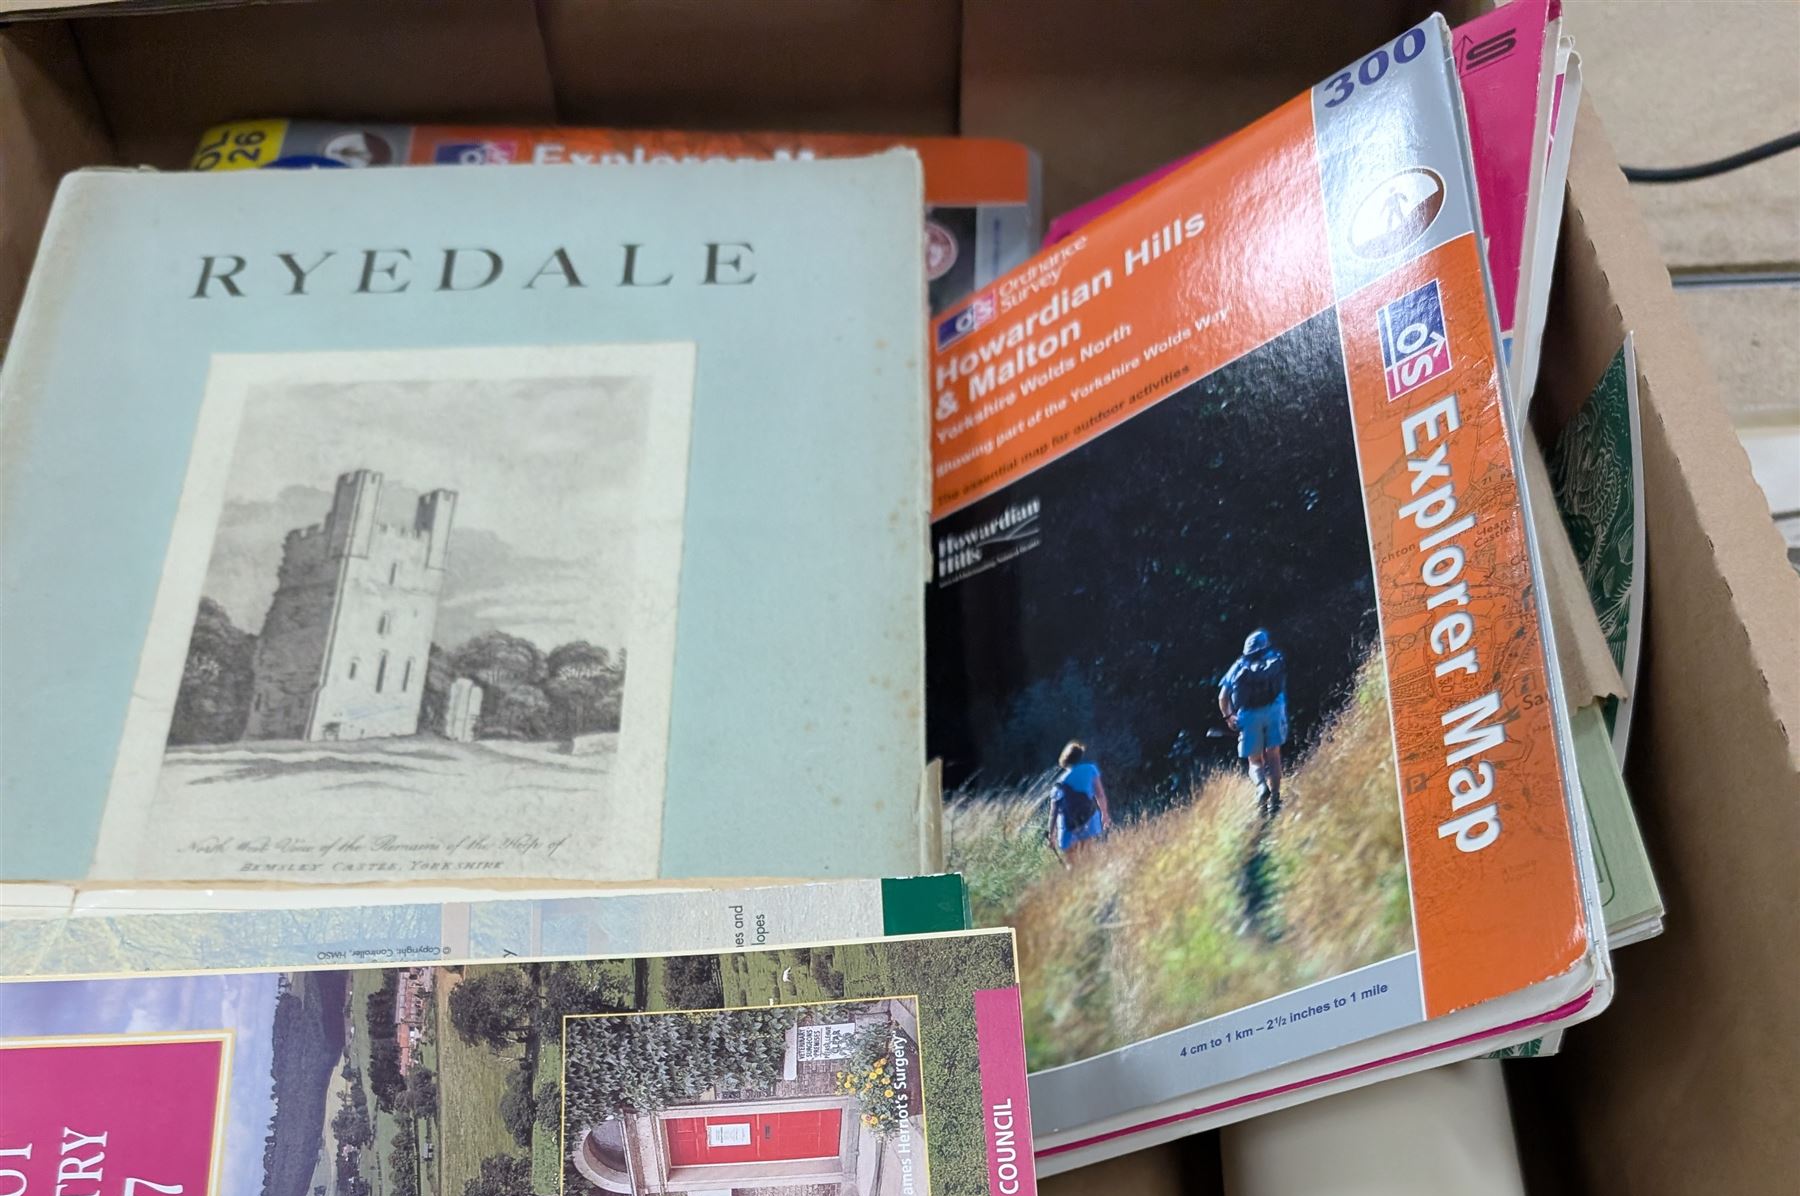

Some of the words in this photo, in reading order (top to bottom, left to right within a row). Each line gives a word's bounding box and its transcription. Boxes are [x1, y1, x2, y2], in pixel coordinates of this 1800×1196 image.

[1322, 27, 1427, 108] 300
[228, 130, 267, 163] 26
[187, 240, 761, 300] RYEDALE
[934, 268, 1114, 391] Howardian
[1124, 212, 1206, 276] Hills
[1000, 268, 1063, 314] Survey
[968, 319, 1082, 403] Malton
[1020, 353, 1076, 396] Wolds
[1080, 323, 1133, 362] North
[1071, 356, 1141, 402] Yorkshire
[1143, 327, 1192, 361] Wolds
[1073, 402, 1125, 434] outdoor
[1129, 364, 1190, 405] activities
[938, 497, 1040, 558] Howardian
[938, 547, 982, 578] Hills
[1398, 391, 1481, 678] Explorer
[1437, 690, 1506, 853] Map
[728, 905, 744, 929] and
[316, 950, 347, 960] HMSO
[1179, 1047, 1188, 1058] 4
[1190, 1041, 1208, 1056] cm
[1210, 1036, 1223, 1049] to
[1235, 1026, 1254, 1041] km
[1289, 1001, 1331, 1024] inches
[1333, 996, 1347, 1009] to
[1361, 983, 1389, 1001] mile
[993, 1098, 1020, 1195] COUNCIL
